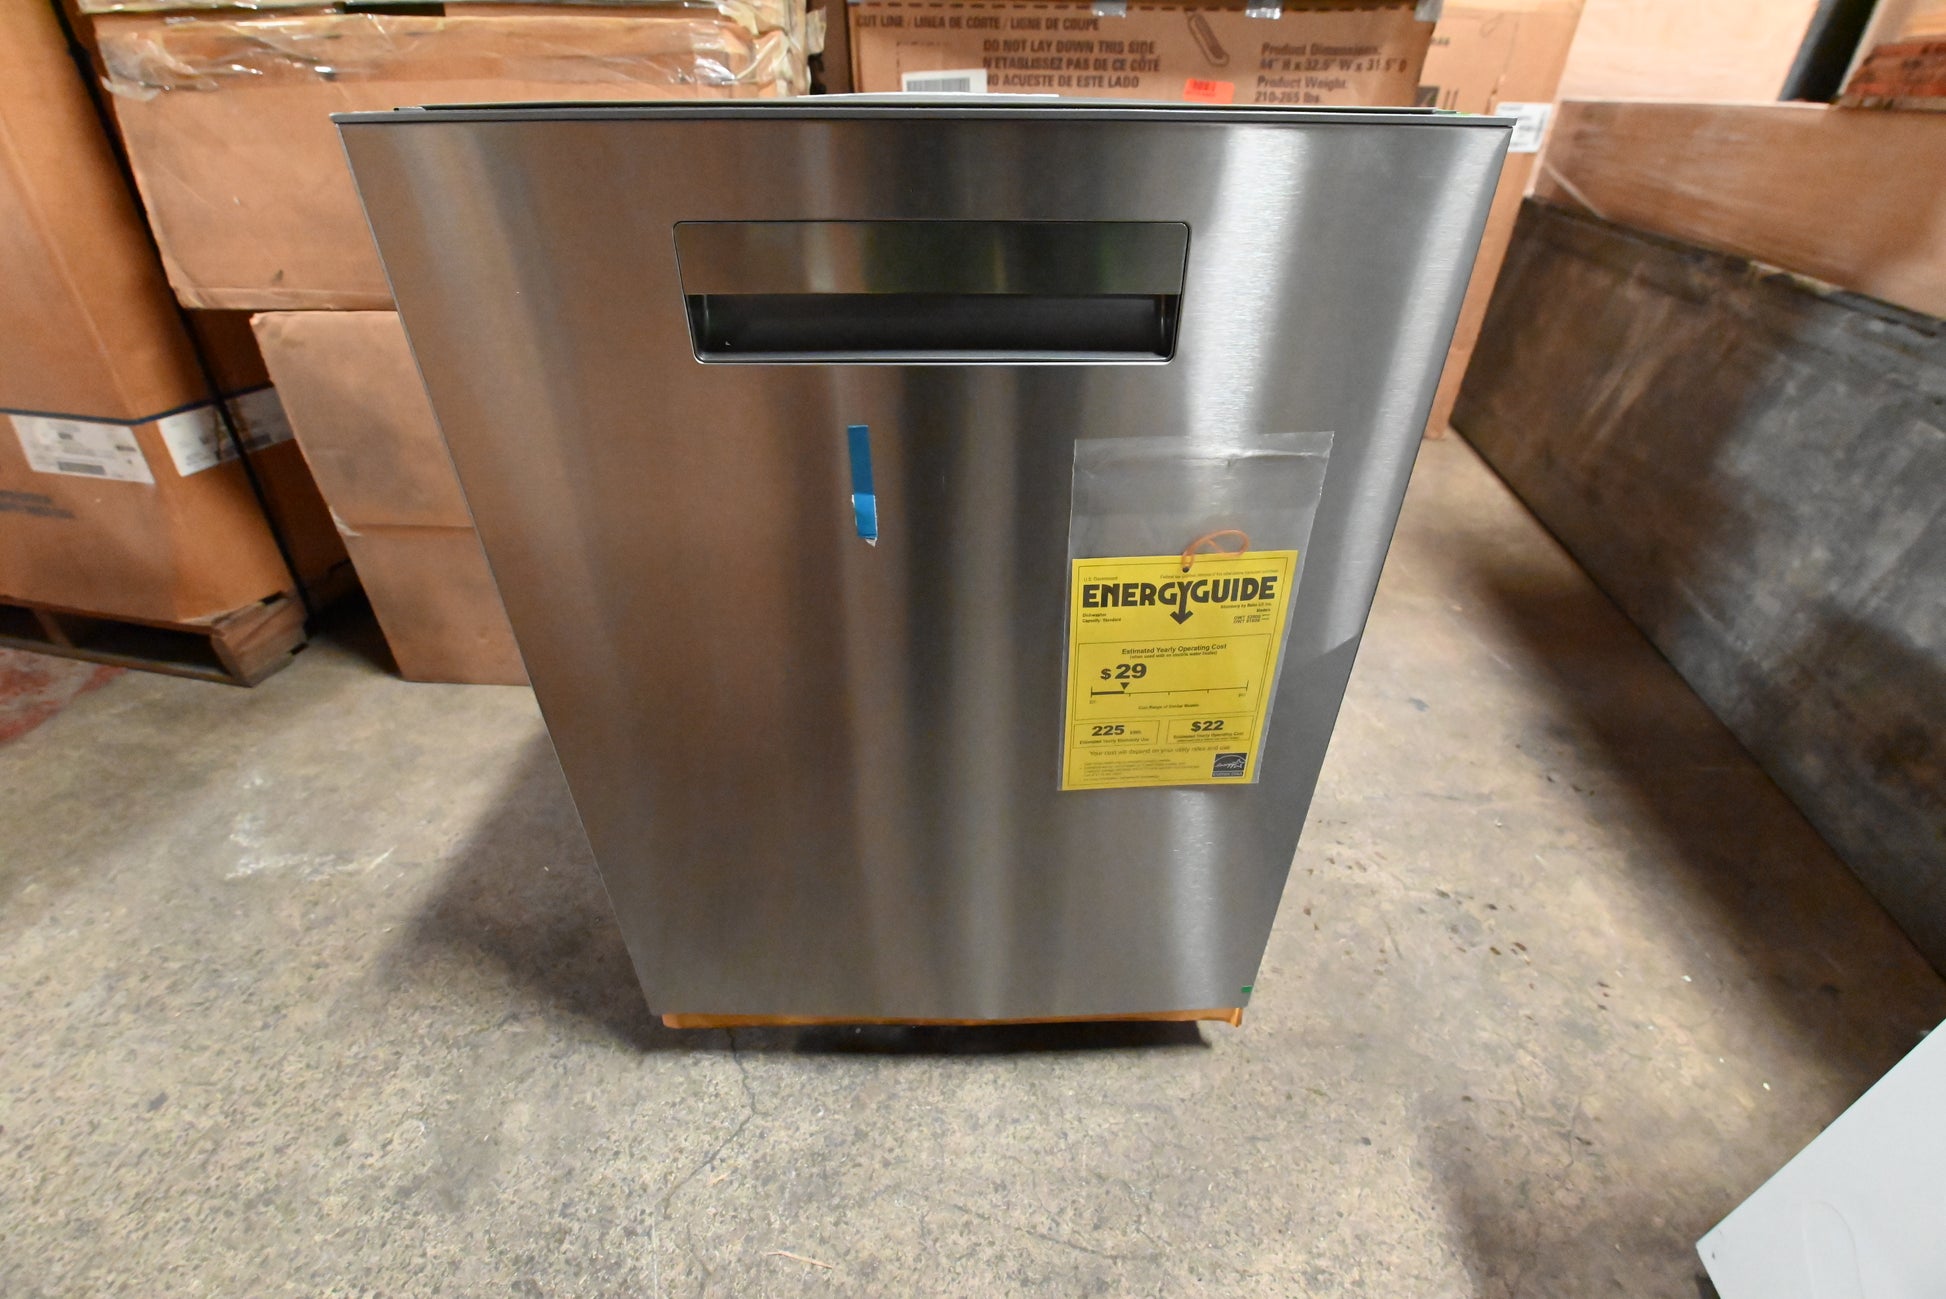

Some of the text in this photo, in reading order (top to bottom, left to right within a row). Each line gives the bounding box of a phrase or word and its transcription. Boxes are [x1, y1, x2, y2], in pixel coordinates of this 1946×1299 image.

[881, 15, 903, 28] LINE
[949, 17, 962, 29] DE
[1045, 18, 1058, 30] DE
[983, 39, 1155, 54] DO NOT LAY DOWN THIS SIDE
[1261, 42, 1306, 55] Product
[1066, 57, 1089, 70] PAS
[1093, 58, 1108, 71] DE
[1112, 58, 1127, 71] CE
[1339, 59, 1352, 71] W
[1355, 62, 1362, 72] x
[1003, 74, 1054, 87] ACUESTE
[1058, 75, 1073, 87] DE
[1076, 75, 1104, 88] ESTE
[1107, 76, 1140, 89] LADO
[1257, 75, 1301, 89] Product
[1082, 576, 1278, 610] ENERGYGUIDE
[1121, 647, 1155, 655] Estimated
[1156, 646, 1176, 655] Yearly
[1178, 645, 1210, 654] Operating
[1114, 663, 1147, 680] 29
[1091, 725, 1125, 737] 225
[1190, 720, 1224, 732] $22
